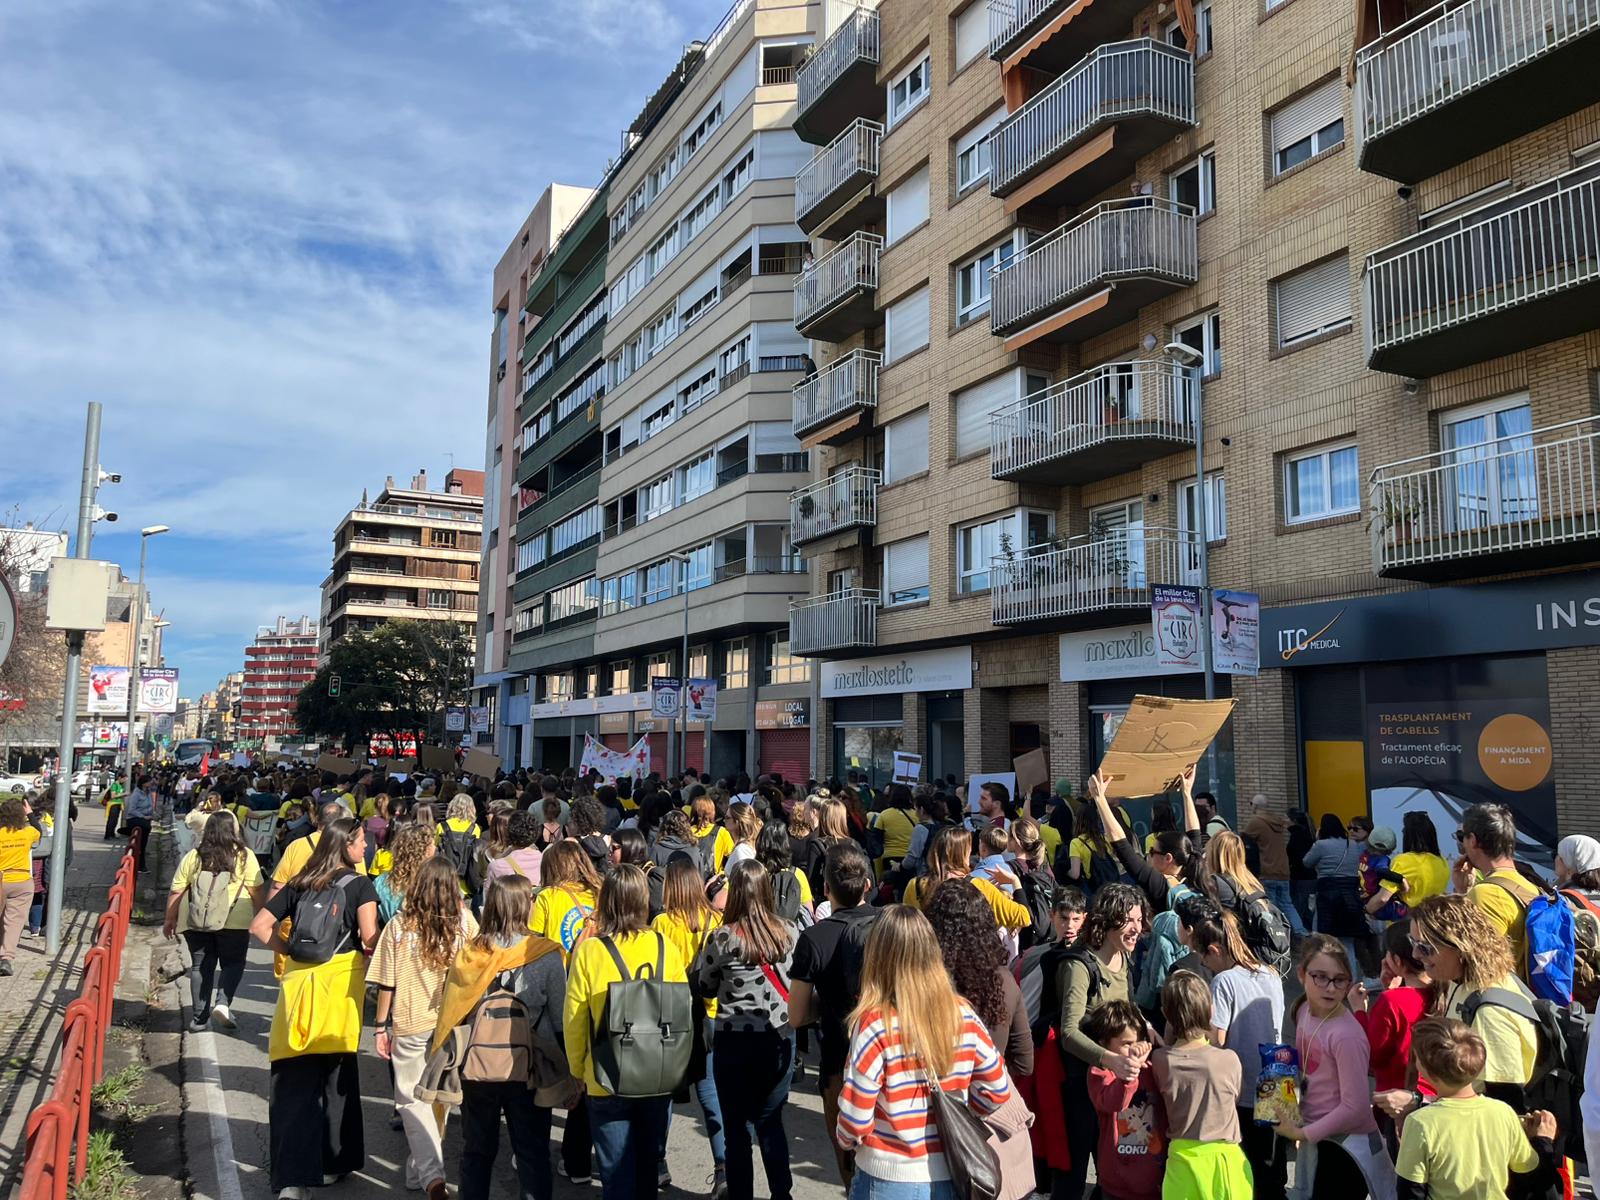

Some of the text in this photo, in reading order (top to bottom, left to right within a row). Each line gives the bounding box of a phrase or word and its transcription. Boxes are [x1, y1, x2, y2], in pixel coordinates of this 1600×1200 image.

[1163, 589, 1182, 597] millor
[1182, 590, 1196, 598] Circ
[1536, 598, 1600, 630] INS
[1170, 621, 1194, 641] CIRC
[1278, 628, 1341, 652] ITC MEDICAL
[833, 660, 913, 690] maxilostetic
[150, 687, 171, 697] CIRC
[660, 695, 676, 705] CIRC
[785, 702, 804, 711] LOCAL
[783, 715, 805, 725] LLOGAT
[1379, 712, 1472, 723] TRASPLANTAMENT
[1380, 726, 1440, 735] DE CABELLS
[1381, 742, 1462, 754] Tractament eficaç
[1485, 746, 1546, 756] FINANÇAMENT
[1381, 754, 1447, 765] de l'ALOPÈCIA
[1117, 1145, 1148, 1155] GOKU
